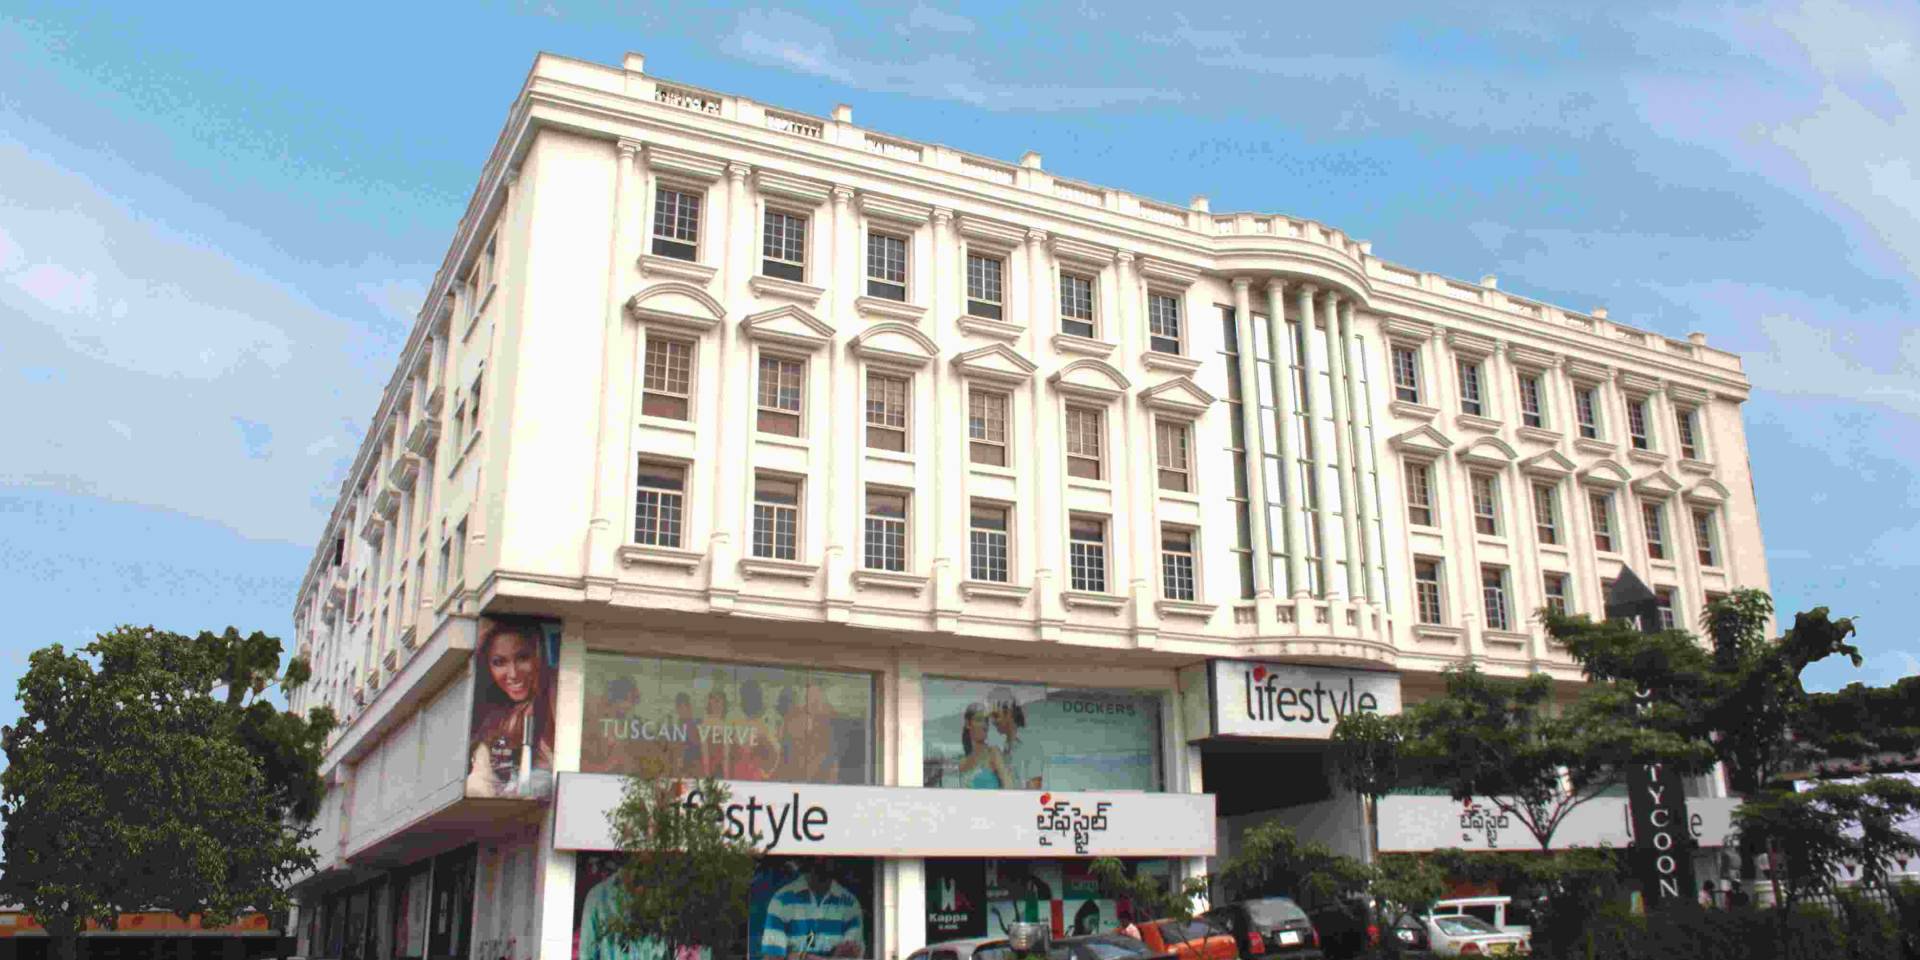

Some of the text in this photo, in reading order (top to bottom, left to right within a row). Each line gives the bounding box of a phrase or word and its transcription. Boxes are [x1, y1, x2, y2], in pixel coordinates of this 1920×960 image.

[1062, 700, 1136, 717] DOCKERS
[1245, 667, 1378, 724] lifestyle
[599, 718, 760, 746] TUSCAN VERVE
[1643, 763, 1679, 898] TYCOON
[928, 912, 968, 924] Kappa
